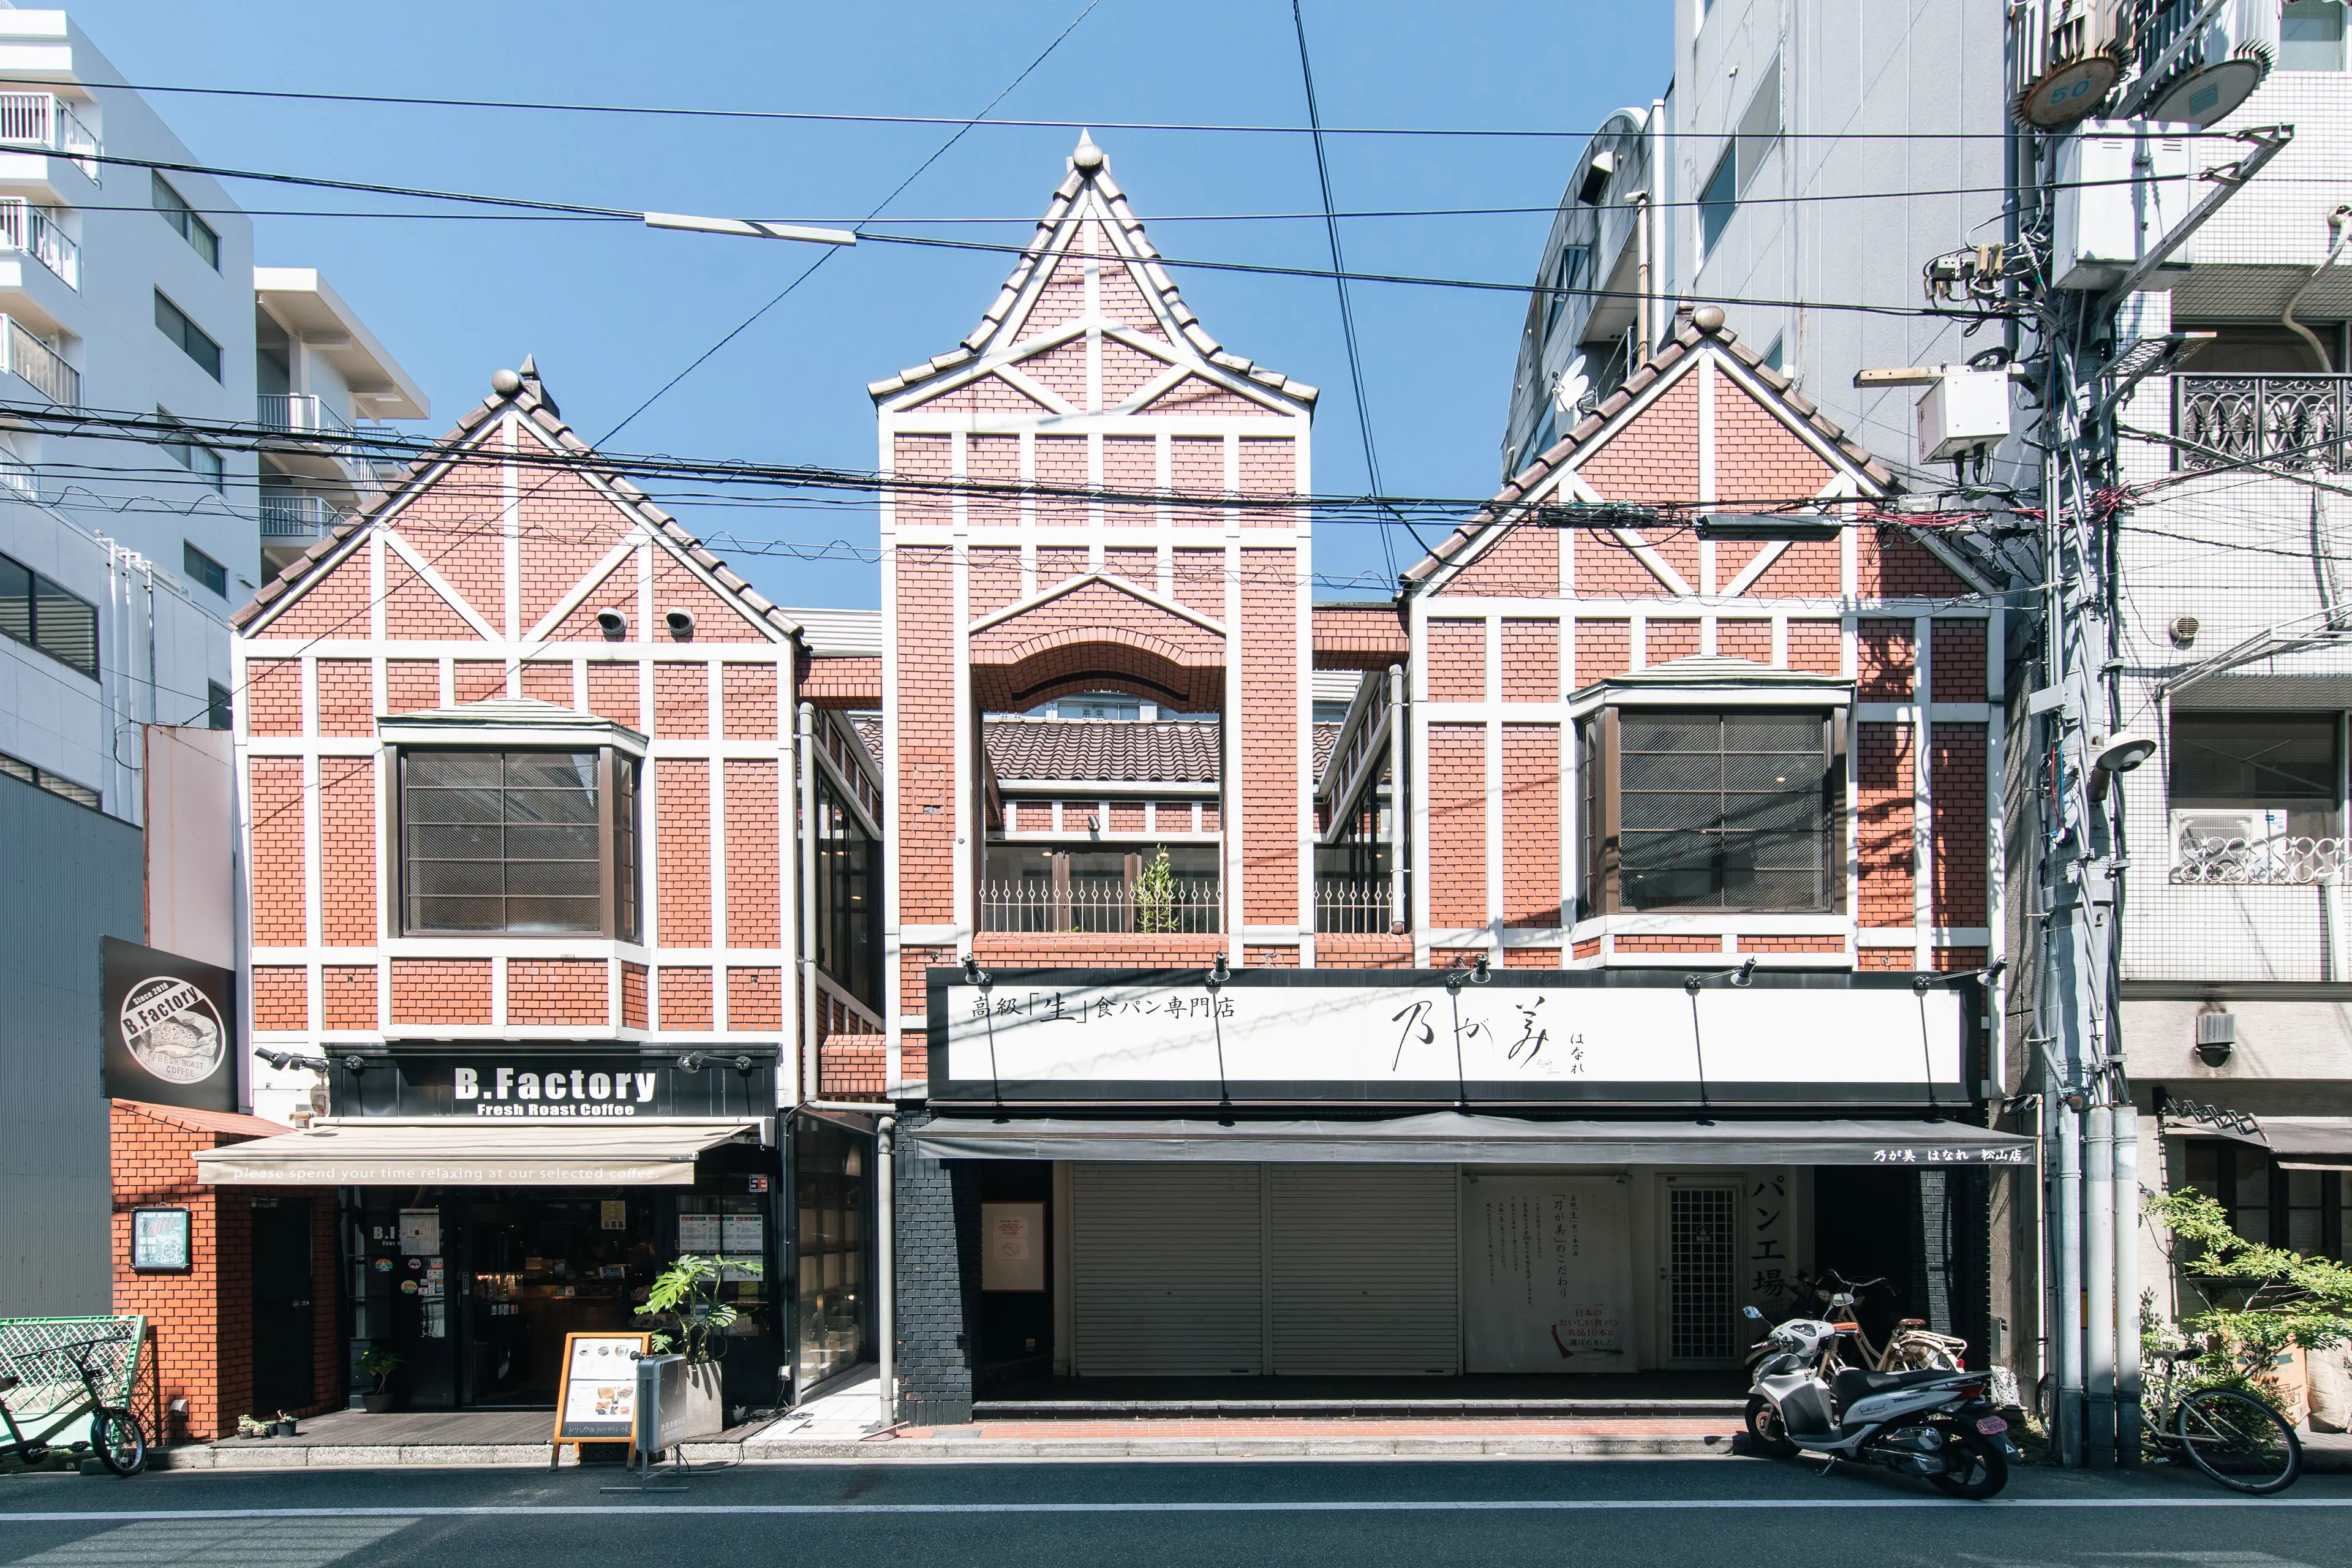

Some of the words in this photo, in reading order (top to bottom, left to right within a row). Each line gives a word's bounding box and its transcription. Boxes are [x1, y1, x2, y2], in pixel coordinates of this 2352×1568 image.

[2049, 80, 2090, 104] 50
[132, 990, 153, 1005] Since
[152, 982, 169, 995] 2018
[122, 986, 199, 1036] B.Factory
[972, 992, 1235, 1023] 高級「生」食パン専門店
[1392, 996, 1549, 1072] 乃が美
[153, 1054, 178, 1065] FRESH
[181, 1059, 204, 1070] ROAST
[1570, 1033, 1586, 1074] はなれ
[166, 1066, 194, 1077] COFFEE
[455, 1068, 656, 1102] B.Factory
[477, 1104, 524, 1116] Fresh
[529, 1104, 576, 1116] Roast
[580, 1104, 635, 1116] Coffee
[1873, 1149, 1917, 1162] 乃が美
[1928, 1149, 1969, 1161] はなれ
[1981, 1149, 2026, 1162] 松山店
[234, 1167, 284, 1180] please
[290, 1167, 334, 1180] spend
[341, 1169, 374, 1181] your
[382, 1168, 415, 1178] time
[421, 1168, 483, 1181] relaxing
[489, 1169, 503, 1178] at
[509, 1169, 533, 1178] our
[540, 1168, 603, 1178] selected
[609, 1167, 658, 1178] coffee.
[1552, 1194, 1567, 1298] 「乃が美」のこだわり
[1751, 1175, 1785, 1297] パン工場
[1568, 1329, 1615, 1337] 名品10本に
[1987, 1422, 2005, 1431] 8906
